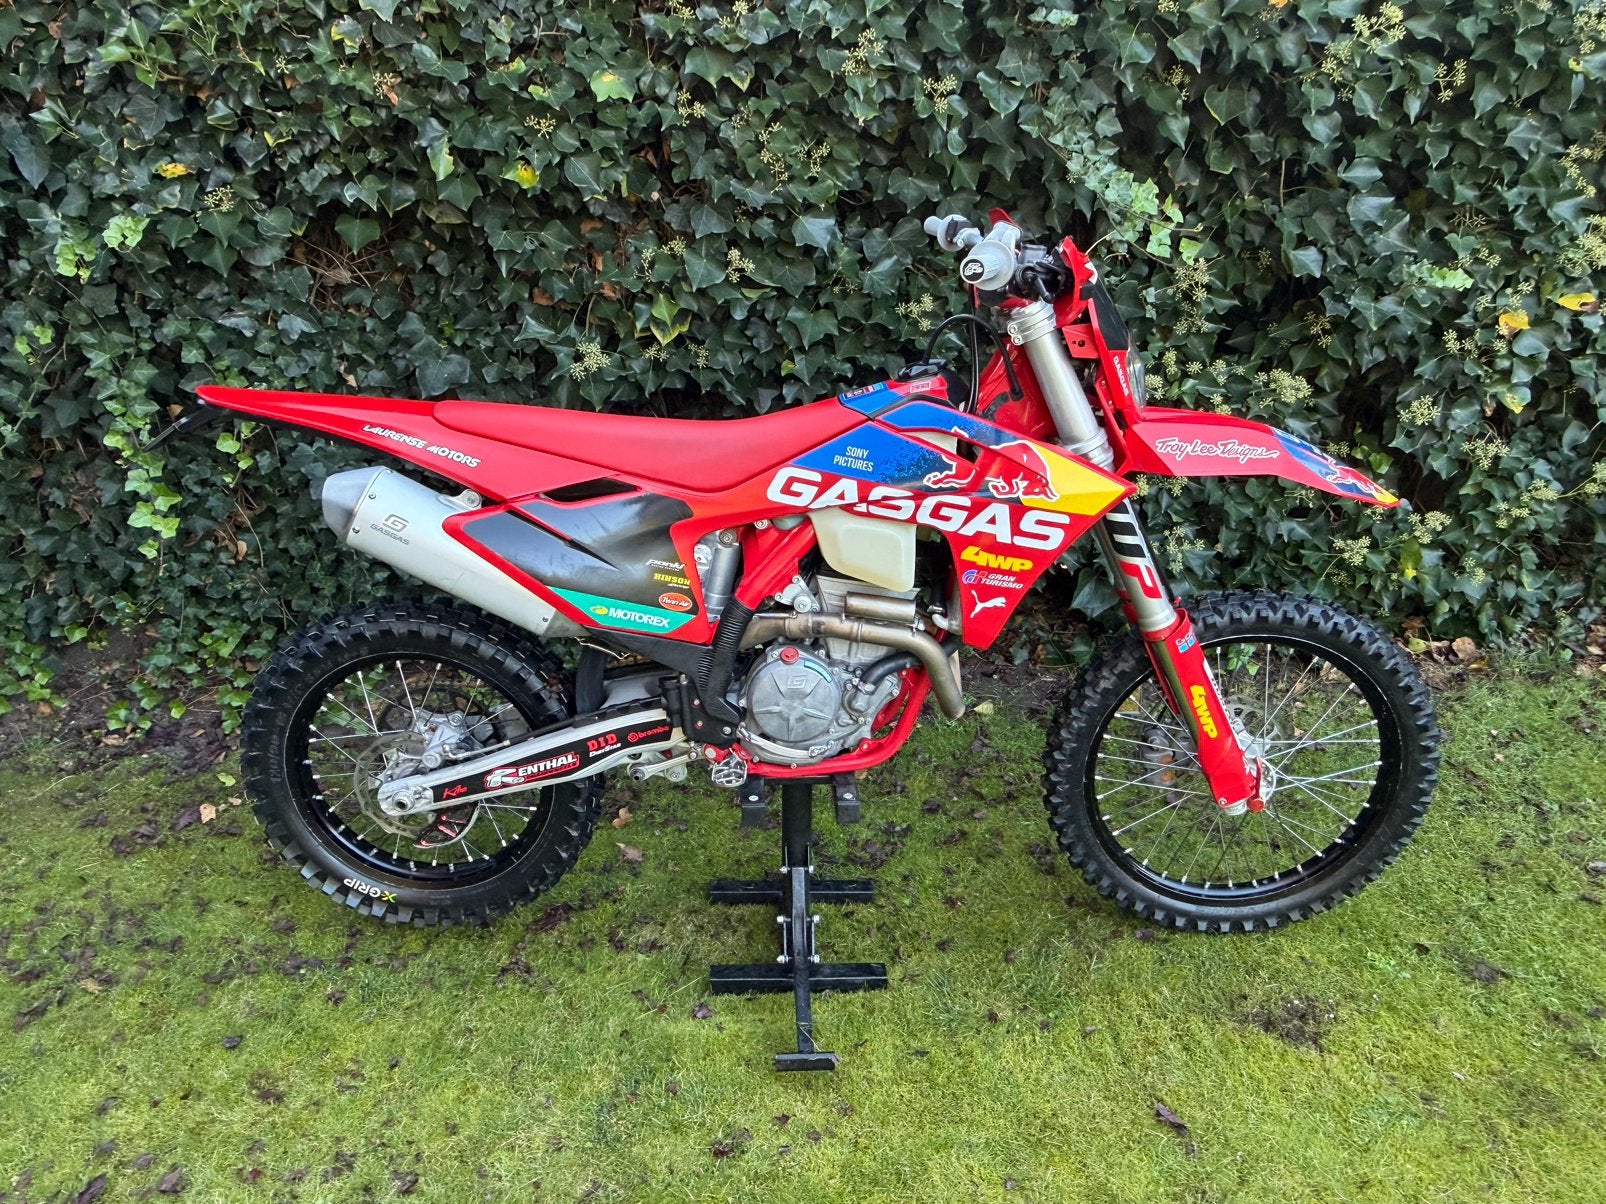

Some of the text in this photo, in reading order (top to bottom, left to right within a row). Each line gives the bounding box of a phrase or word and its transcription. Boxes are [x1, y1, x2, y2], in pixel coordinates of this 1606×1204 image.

[362, 424, 482, 468] LAURENSE MOTORS
[845, 446, 870, 459] SONY
[1156, 437, 1189, 460] Troy
[1190, 439, 1218, 456] Lee
[1218, 440, 1280, 464] Designs
[833, 454, 875, 473] PICTURES
[766, 466, 1070, 551] GASGAS
[370, 523, 410, 546] GASGAS
[961, 546, 1033, 572] 4WP
[654, 573, 690, 585] HINSON
[981, 578, 1024, 590] TURISMO
[988, 573, 1016, 582] GRAN
[662, 596, 679, 605] Twin
[608, 608, 670, 628] MOTOREX
[1190, 685, 1218, 739] 4WP
[638, 725, 670, 738] brembo
[343, 878, 398, 904] X-GRIP
